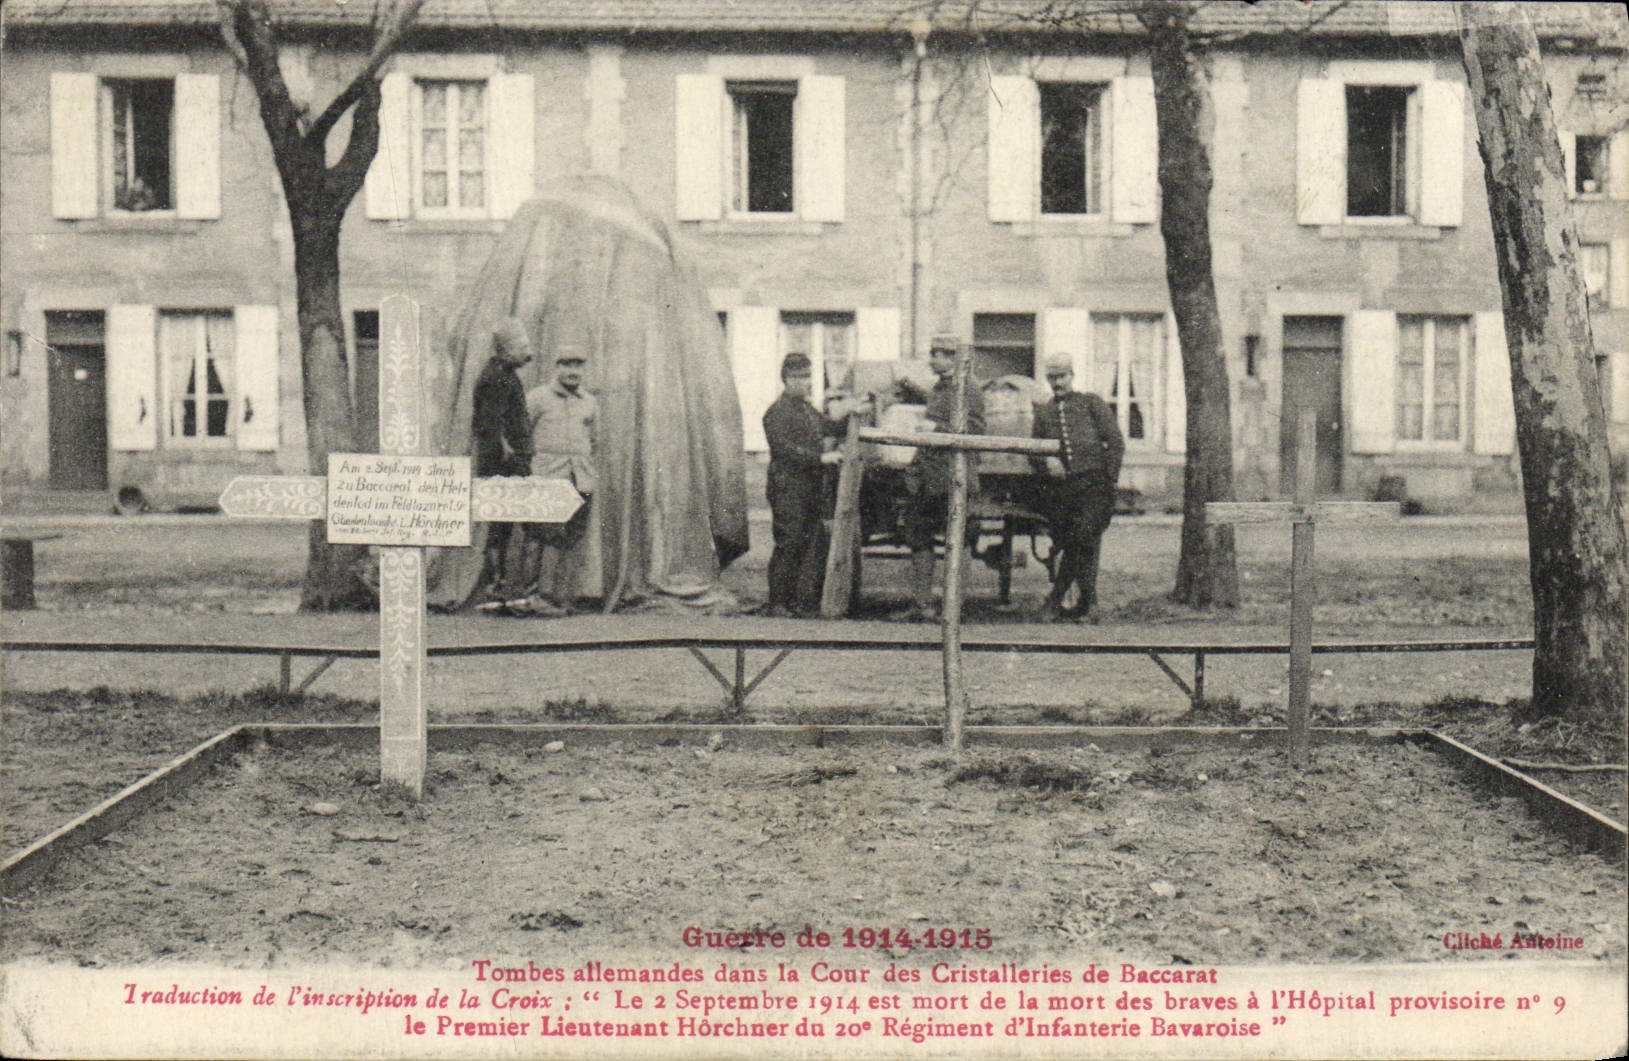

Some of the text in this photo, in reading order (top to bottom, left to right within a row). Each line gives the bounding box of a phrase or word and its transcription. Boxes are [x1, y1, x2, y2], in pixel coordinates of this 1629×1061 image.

[340, 460, 360, 473] Am
[355, 477, 411, 493] Baccarat
[418, 481, 438, 494] den
[375, 498, 389, 510] im
